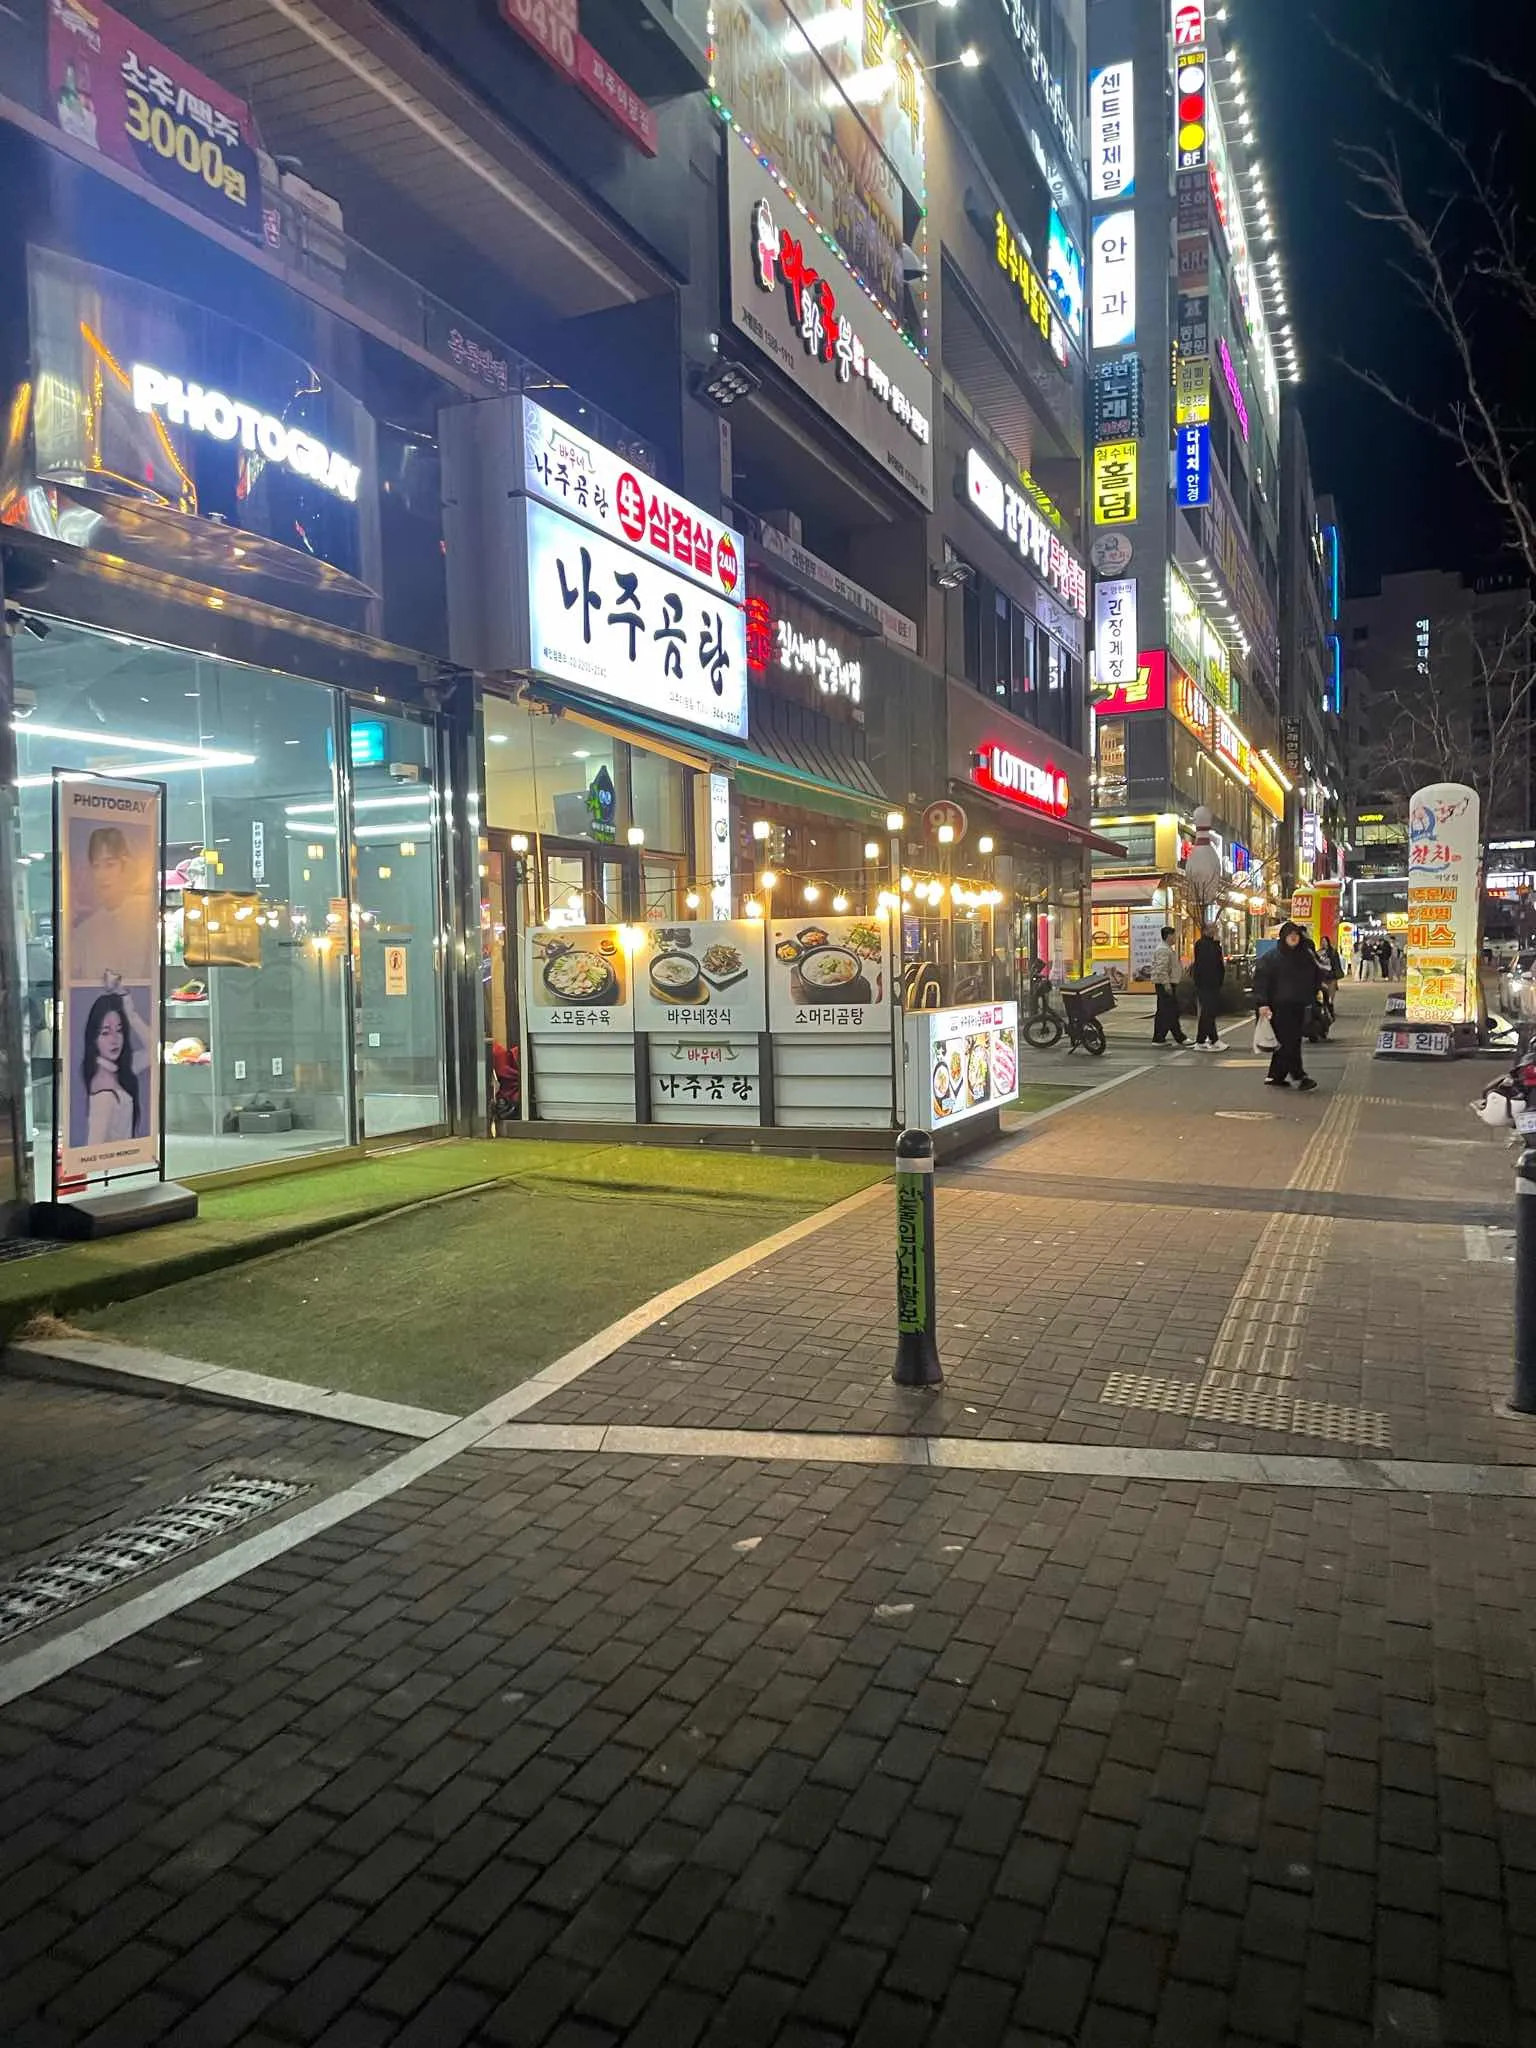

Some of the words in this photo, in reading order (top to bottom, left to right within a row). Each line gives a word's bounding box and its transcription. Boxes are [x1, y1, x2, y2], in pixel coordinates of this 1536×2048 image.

[1175, 20, 1201, 44] 7F
[121, 50, 241, 147] 소주/맥주
[124, 87, 247, 207] 3000원
[1101, 73, 1121, 190] 센트럴제일
[1182, 152, 1201, 166] 6F
[1101, 237, 1127, 316] 안과
[1102, 380, 1129, 418] 노래
[558, 443, 585, 470] 바우네
[1186, 429, 1200, 471] 다비치
[535, 452, 609, 518] 나주곰탕
[1097, 461, 1134, 519] 홀덤
[1187, 474, 1200, 501] 안경
[556, 546, 730, 696] 나주곰탕
[1108, 599, 1123, 678] 간장게장
[1416, 619, 1429, 675] 에펠타워
[73, 793, 148, 813] PHOTOGRAY
[550, 1010, 611, 1026] 소모둠수육
[667, 1008, 732, 1025] 바우네정식
[795, 1008, 864, 1026] 소머리곰탕
[687, 1047, 723, 1064] 바우네
[659, 1074, 753, 1101] 나주곰탕
